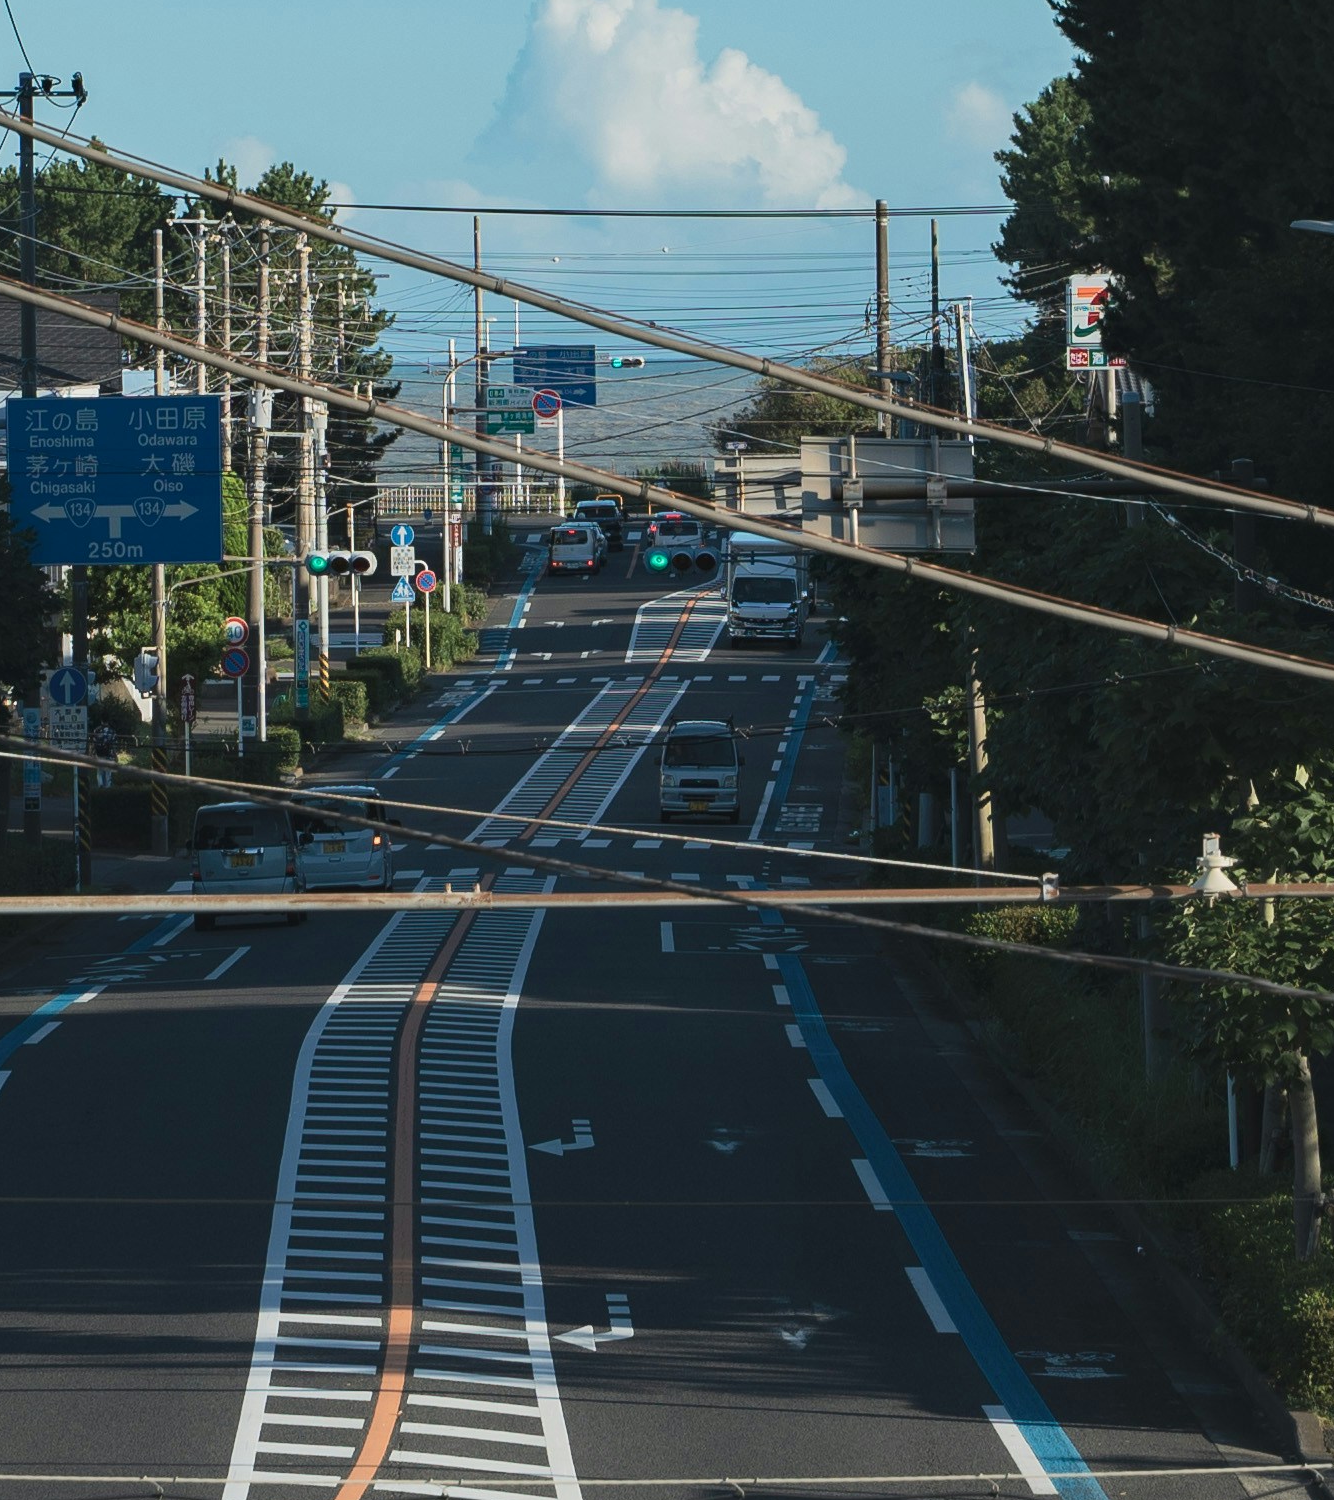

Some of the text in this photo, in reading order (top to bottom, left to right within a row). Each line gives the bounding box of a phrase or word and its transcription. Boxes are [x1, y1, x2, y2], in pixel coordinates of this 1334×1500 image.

[25, 407, 99, 432] 江の島
[128, 406, 206, 431] 小田原
[29, 435, 95, 448] Enoshima
[138, 434, 198, 447] Odawara
[141, 453, 195, 476] 大磯
[30, 481, 96, 497] Chigasaki
[153, 479, 184, 493] Oiso
[70, 502, 91, 517] 134
[138, 501, 160, 516] 134
[88, 542, 143, 559] 250m
